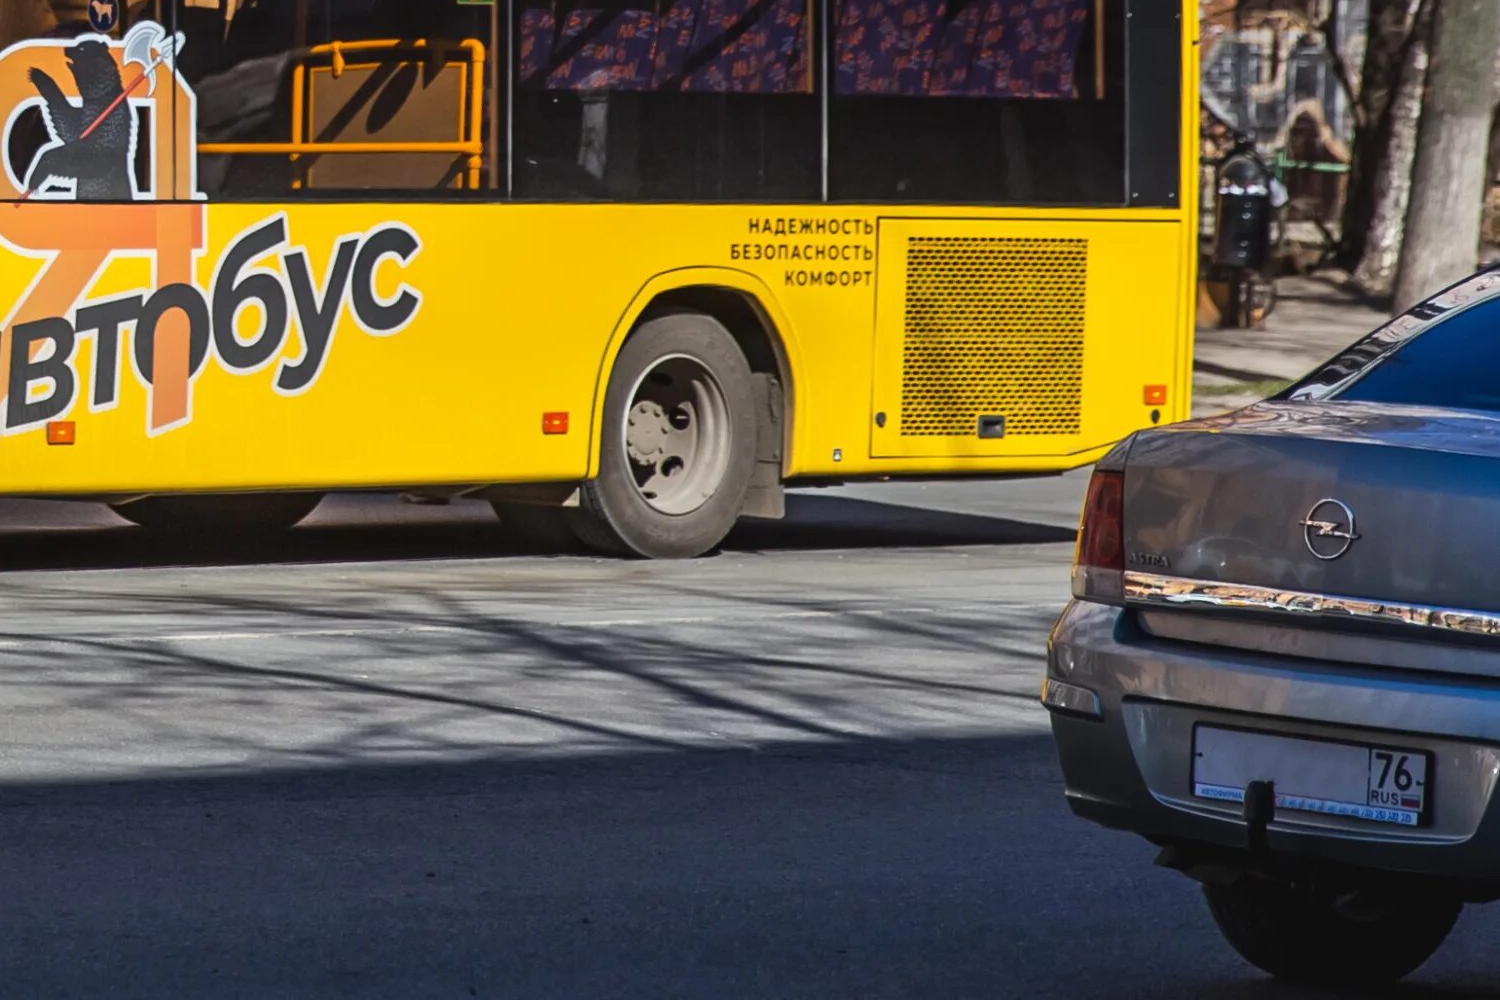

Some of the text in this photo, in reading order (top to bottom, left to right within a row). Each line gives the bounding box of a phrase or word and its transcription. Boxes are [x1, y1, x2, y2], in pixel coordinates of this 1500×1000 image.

[748, 217, 874, 237] НАДЕЖНОСТЬ
[730, 243, 874, 261] БЕЗОПАСНОСТЬ
[784, 270, 873, 286] КОМФОРТ
[1374, 752, 1413, 793] 76
[1370, 788, 1400, 806] RUS
